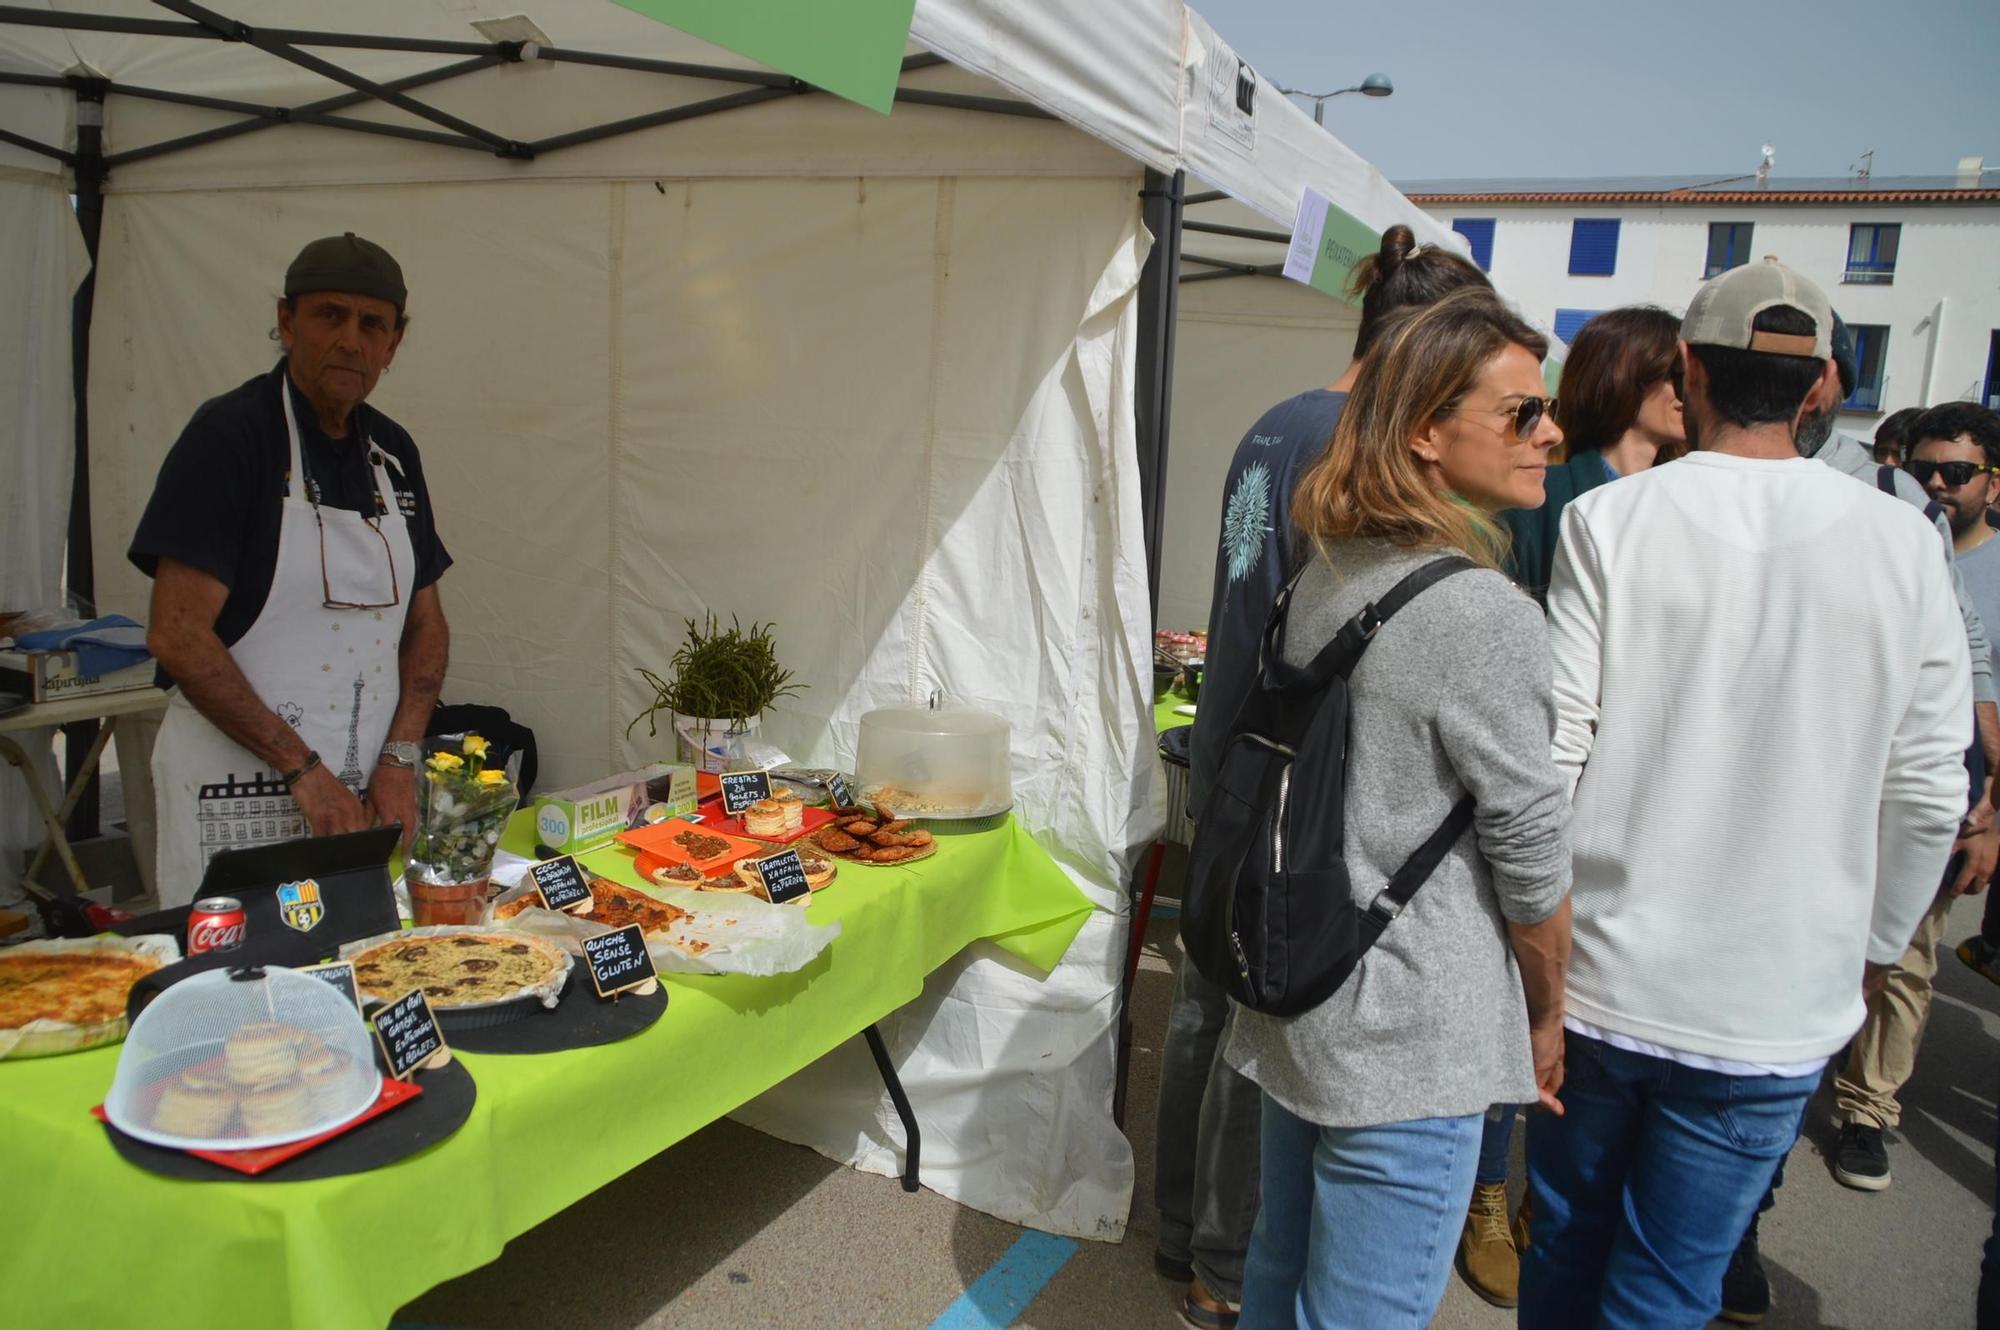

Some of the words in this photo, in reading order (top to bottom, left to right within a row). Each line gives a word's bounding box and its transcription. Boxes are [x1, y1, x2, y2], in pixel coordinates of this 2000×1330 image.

[722, 774, 758, 785] CRESTAS
[581, 796, 618, 824] FILM
[541, 816, 566, 836] 300
[535, 861, 561, 875] COCA
[586, 931, 626, 952] QUICHE
[593, 943, 632, 965] SENSE
[405, 1036, 437, 1065] BOLETS
